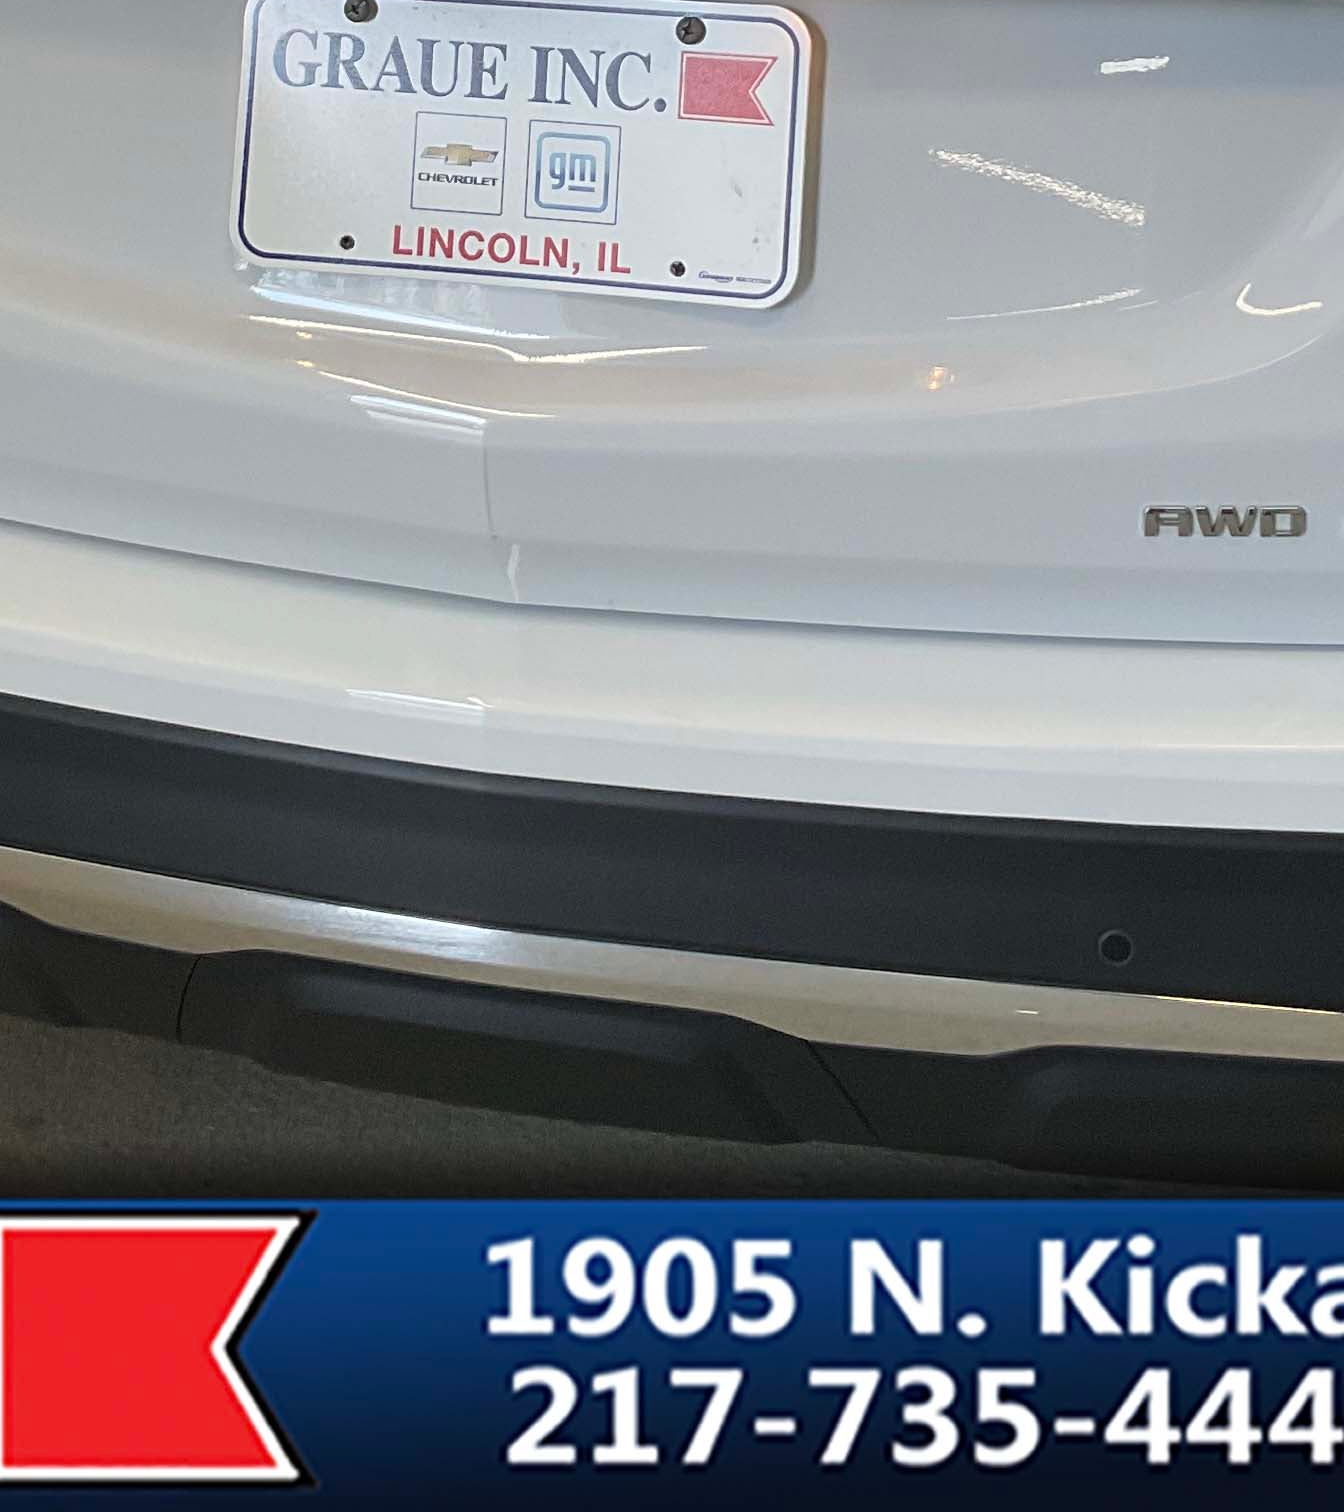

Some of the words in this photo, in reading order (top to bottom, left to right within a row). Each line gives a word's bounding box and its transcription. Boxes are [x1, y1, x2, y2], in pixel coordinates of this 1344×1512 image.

[271, 28, 510, 102] GRAUE
[528, 44, 668, 115] INC.
[418, 171, 499, 187] CHEVROLET
[548, 151, 597, 191] gm
[392, 224, 581, 276] LINCOLN,
[597, 240, 632, 274] IL
[1143, 503, 1308, 538] AWD
